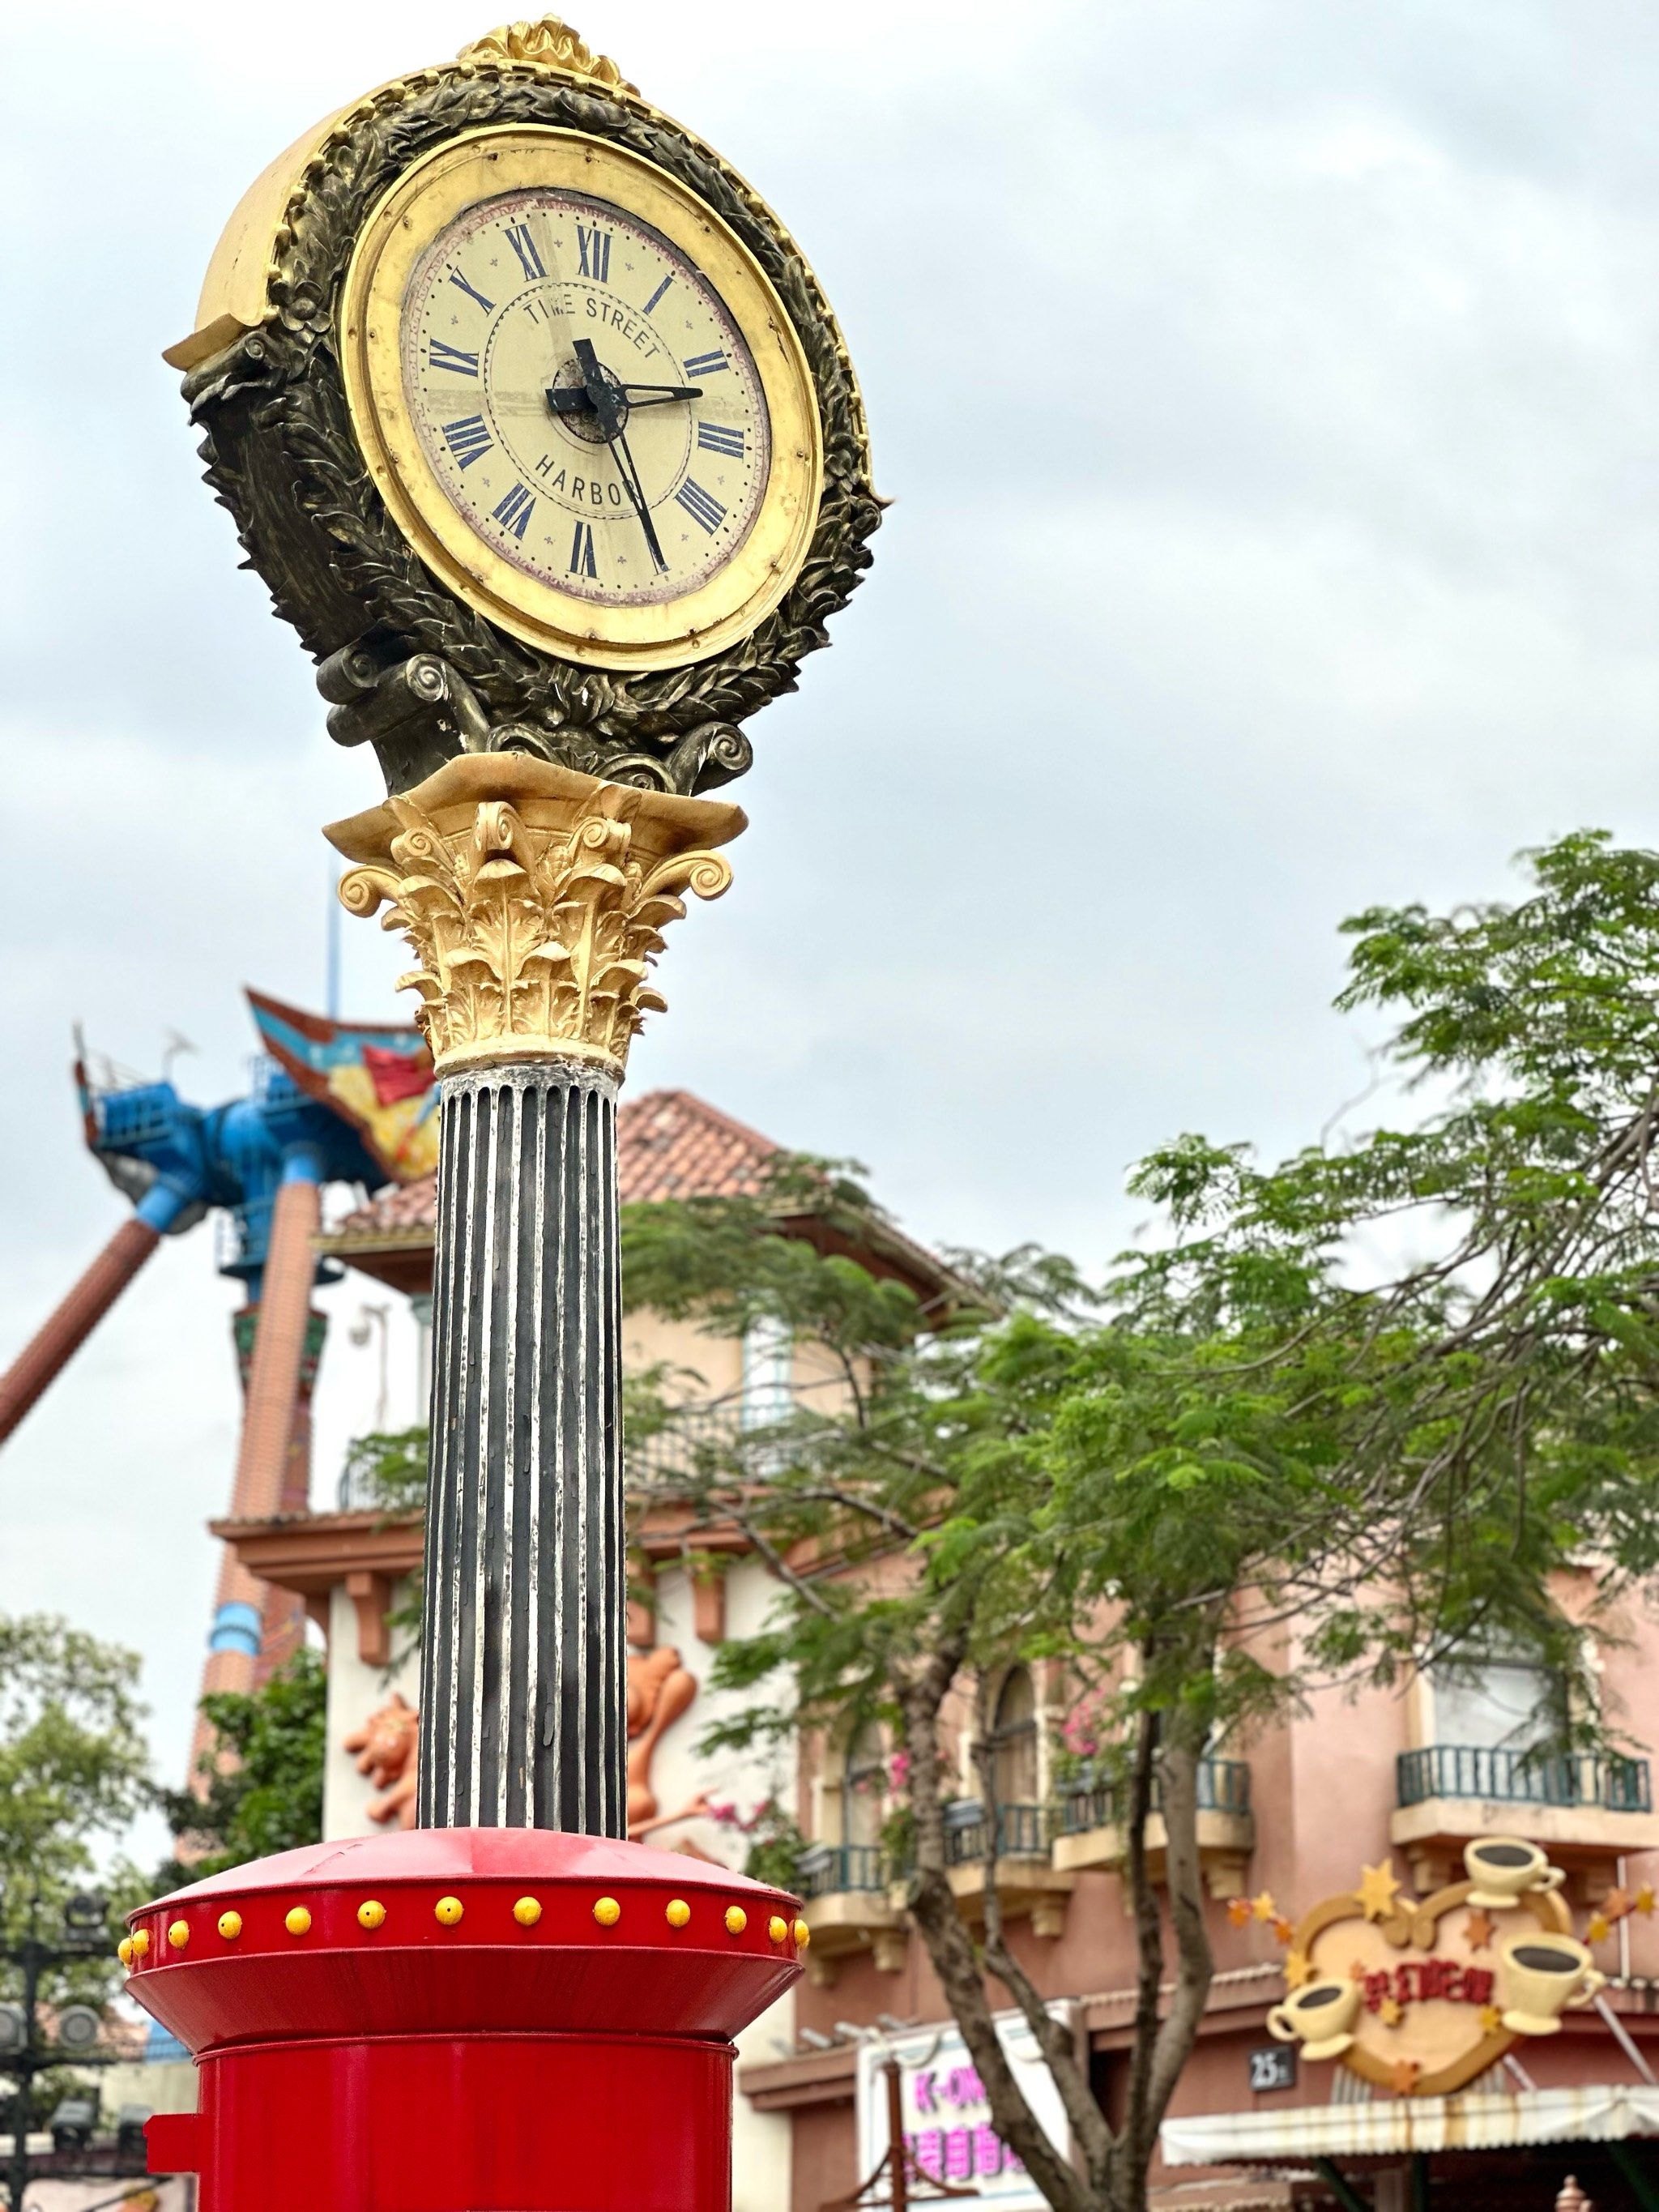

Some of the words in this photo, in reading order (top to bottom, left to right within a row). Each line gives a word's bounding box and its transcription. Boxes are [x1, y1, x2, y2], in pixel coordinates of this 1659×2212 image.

[501, 224, 550, 282] XI
[574, 224, 614, 284] XII
[448, 266, 497, 317] X
[429, 335, 480, 378] IX
[586, 297, 660, 359] STREET
[682, 347, 731, 381] II
[441, 412, 494, 473] VIII
[697, 418, 744, 463] III
[489, 479, 536, 541] VII
[566, 519, 599, 579] VI
